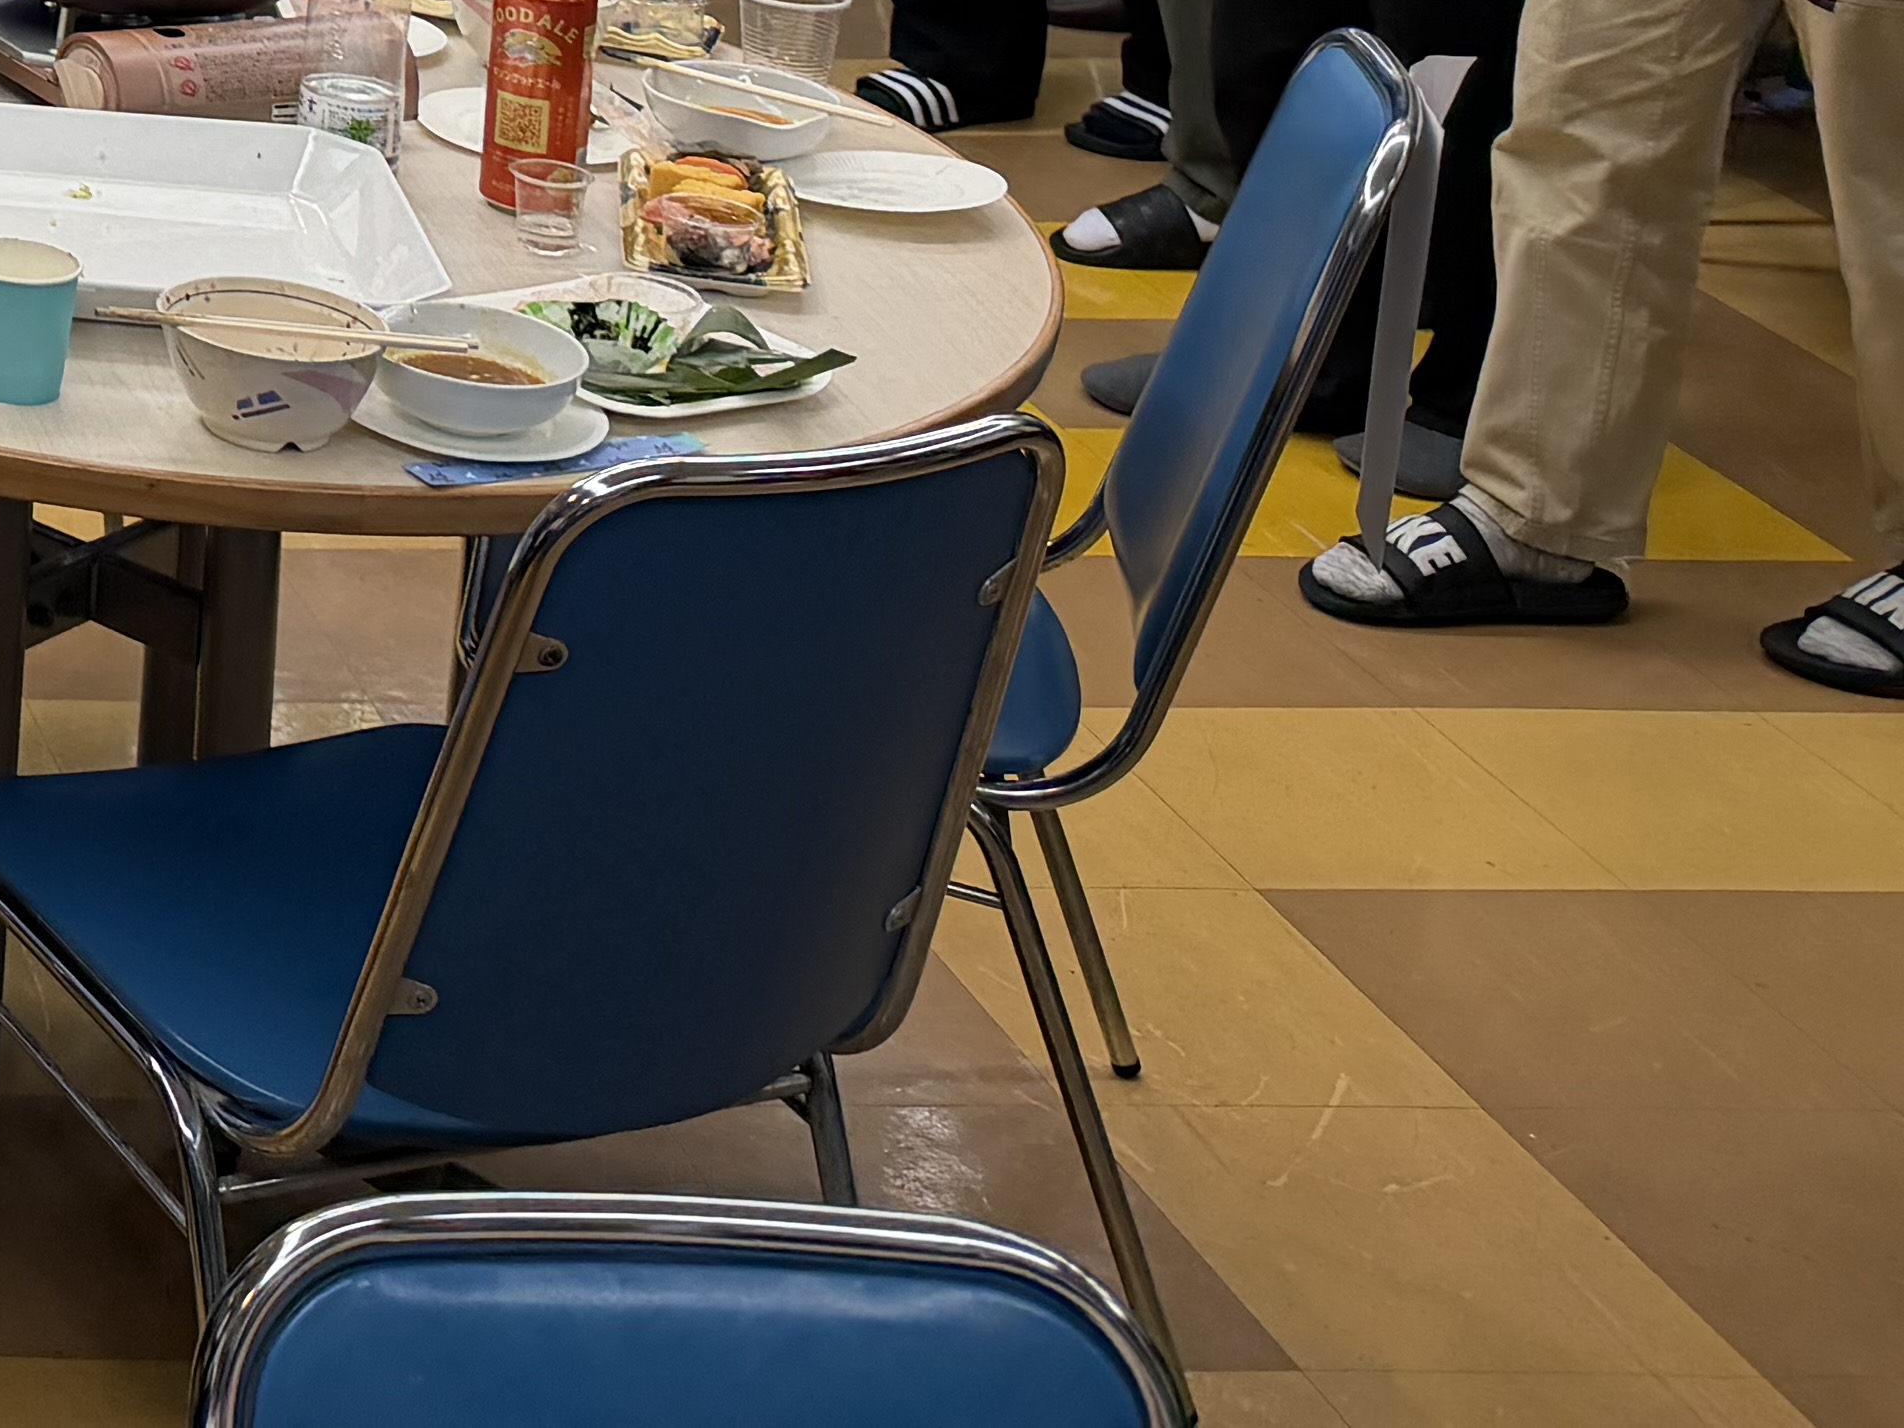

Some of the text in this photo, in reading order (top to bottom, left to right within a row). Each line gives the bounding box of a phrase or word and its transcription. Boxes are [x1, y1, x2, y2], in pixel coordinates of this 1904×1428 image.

[494, 5, 580, 45] OOD ALE
[1384, 513, 1469, 578] IKE
